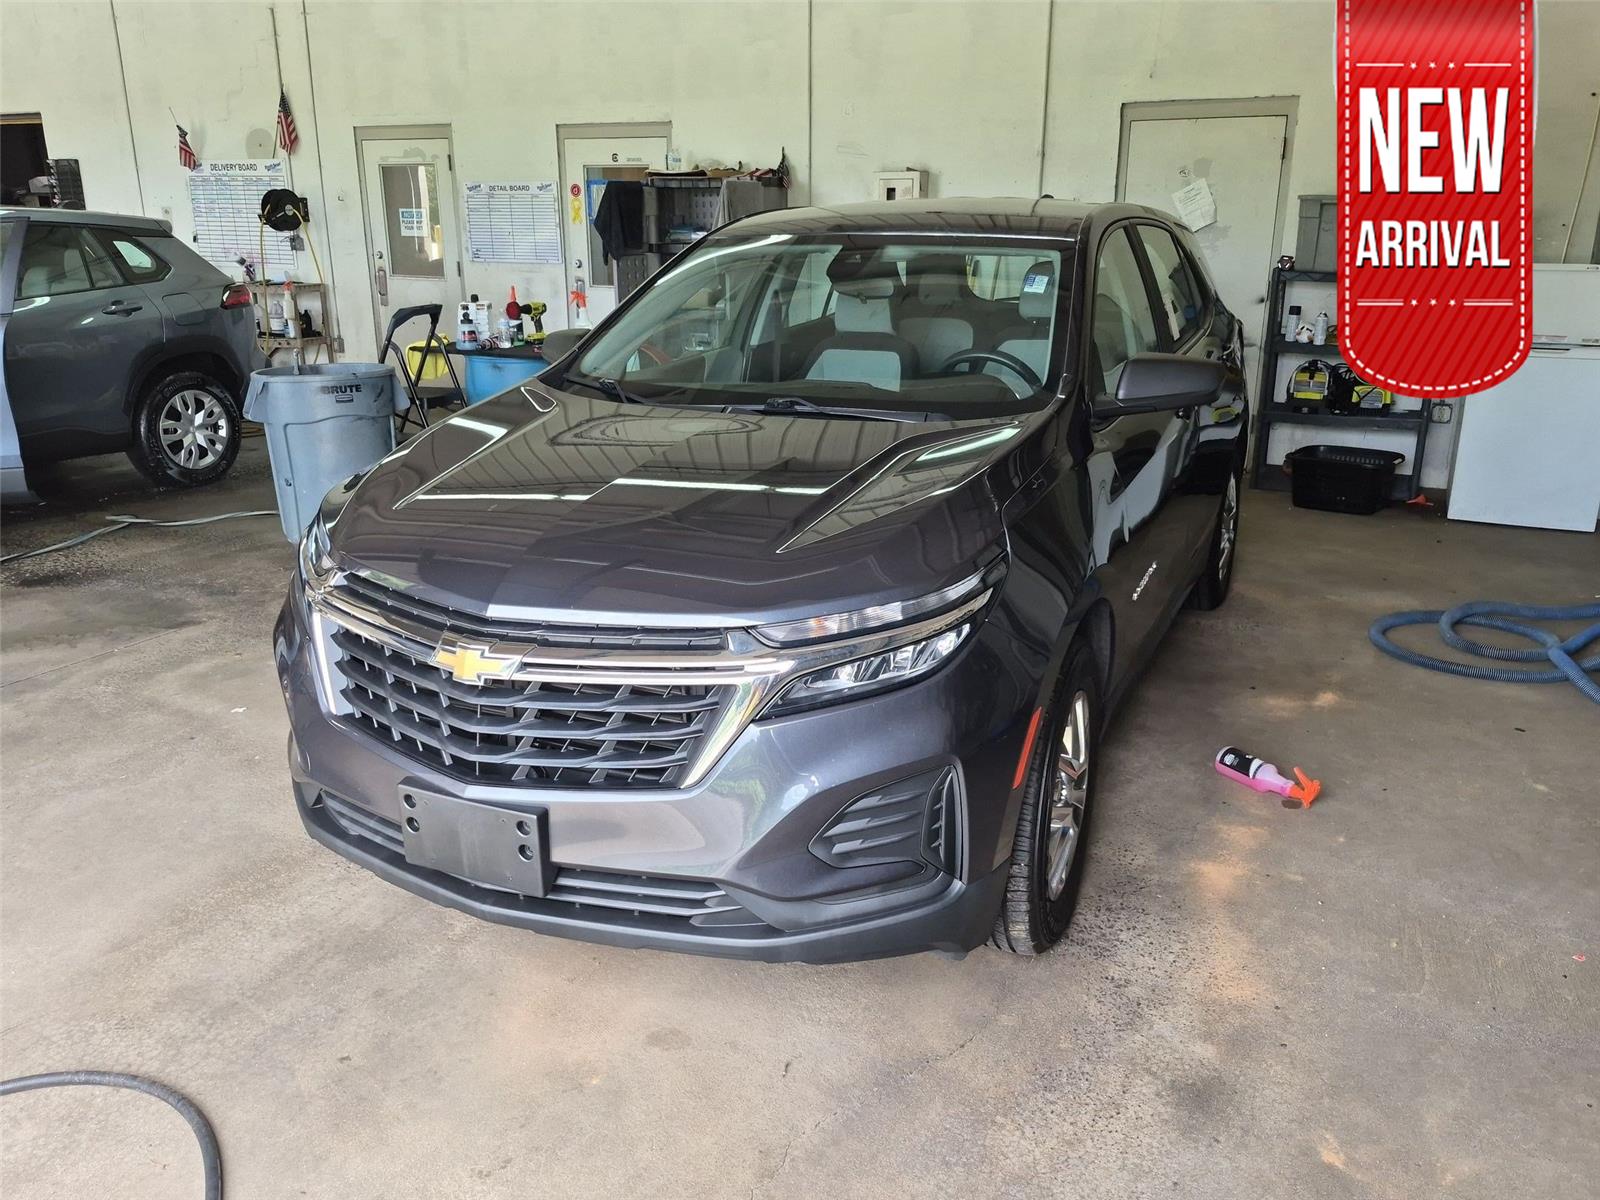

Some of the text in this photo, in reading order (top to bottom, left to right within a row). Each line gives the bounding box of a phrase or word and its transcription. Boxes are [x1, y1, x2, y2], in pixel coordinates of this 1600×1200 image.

[210, 163, 237, 172] DELIVERY
[238, 163, 258, 172] BOARD
[321, 384, 362, 395] BRUTE
